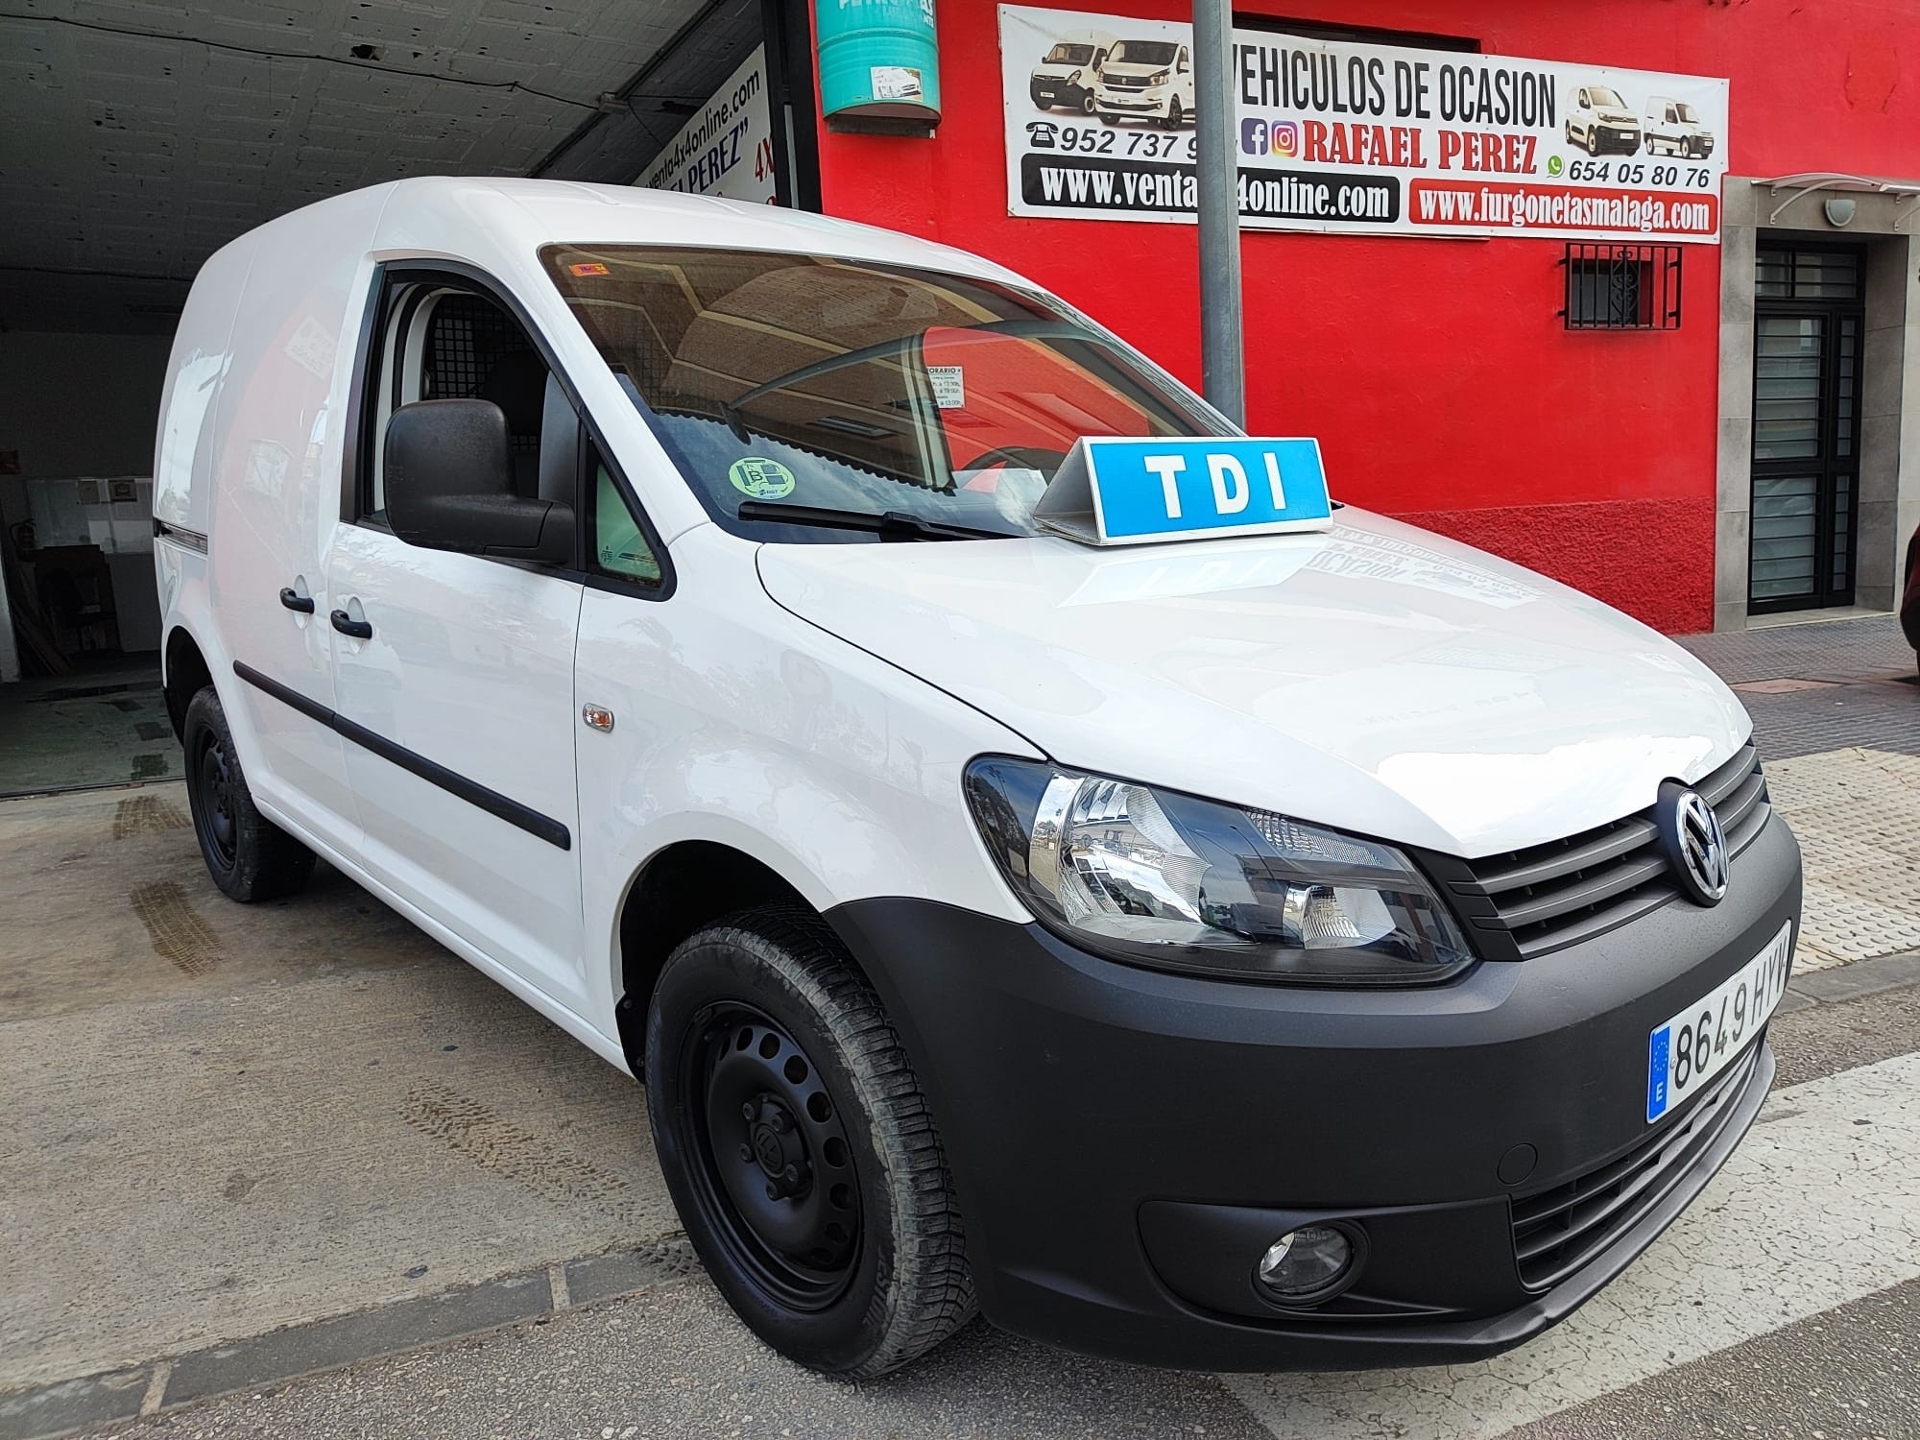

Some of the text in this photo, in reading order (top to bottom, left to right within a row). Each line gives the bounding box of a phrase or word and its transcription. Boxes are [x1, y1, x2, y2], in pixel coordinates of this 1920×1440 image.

[1394, 60, 1431, 120] DE
[1439, 64, 1556, 128] OCASION
[1060, 127, 1116, 154] 952
[1127, 132, 1179, 158] 737
[1303, 120, 1538, 174] RAFAEL PEREZ
[1569, 161, 1711, 188] 654 05 80 76
[1418, 187, 1711, 231] www.furgonetasmalaga.com
[1674, 982, 1748, 1090] 8649
[1655, 1080, 1664, 1103] E
